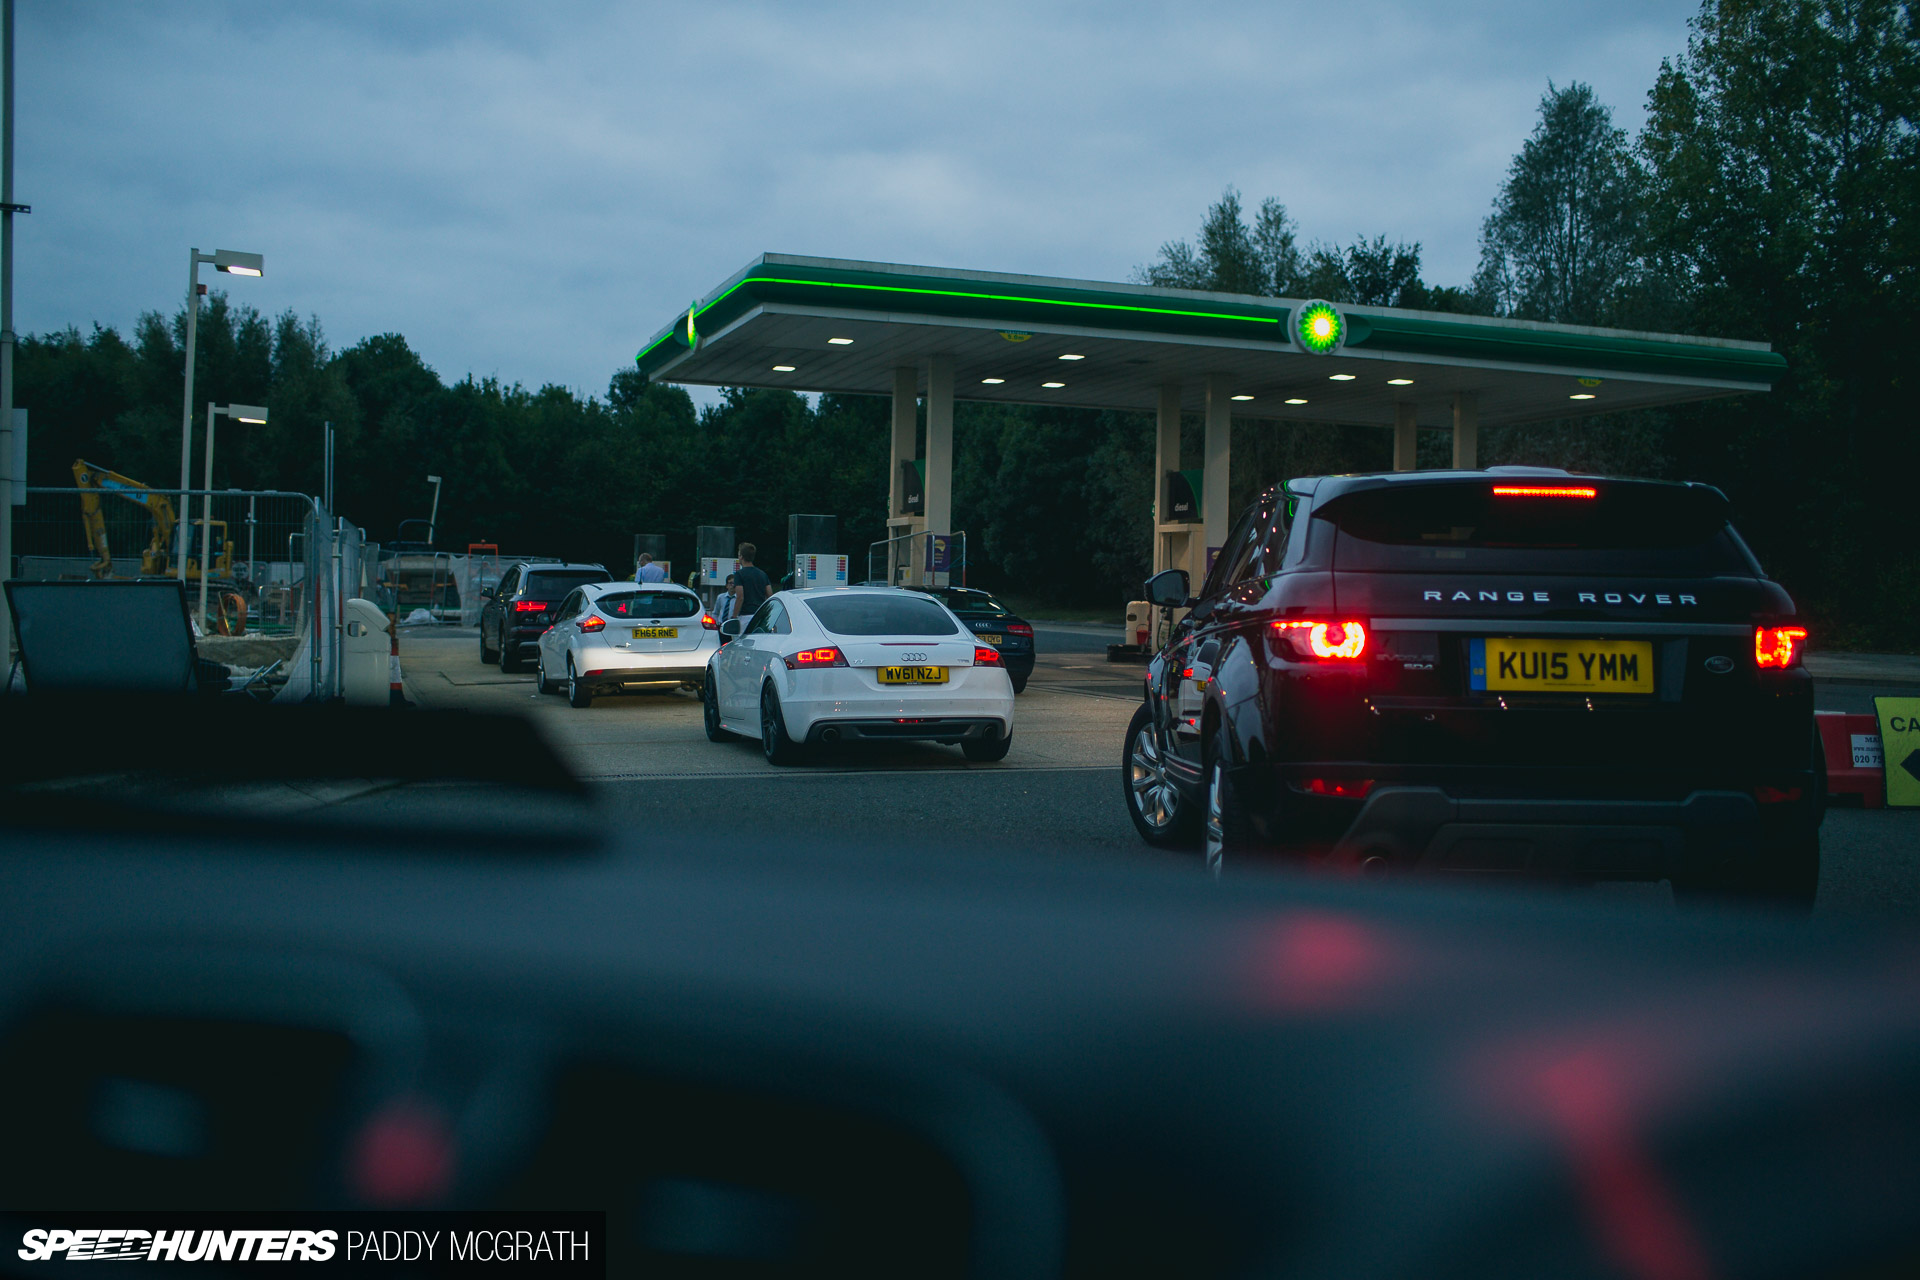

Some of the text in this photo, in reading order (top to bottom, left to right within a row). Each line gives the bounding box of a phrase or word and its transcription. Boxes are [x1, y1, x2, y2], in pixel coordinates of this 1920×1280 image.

[1174, 502, 1189, 512] diesel
[1423, 590, 1698, 605] RANGE ROVER
[635, 629, 675, 638] FH65 RNE
[1499, 651, 1639, 682] KU15 YMM
[886, 667, 942, 680] WV61 NZJ
[1854, 755, 1870, 763] 020
